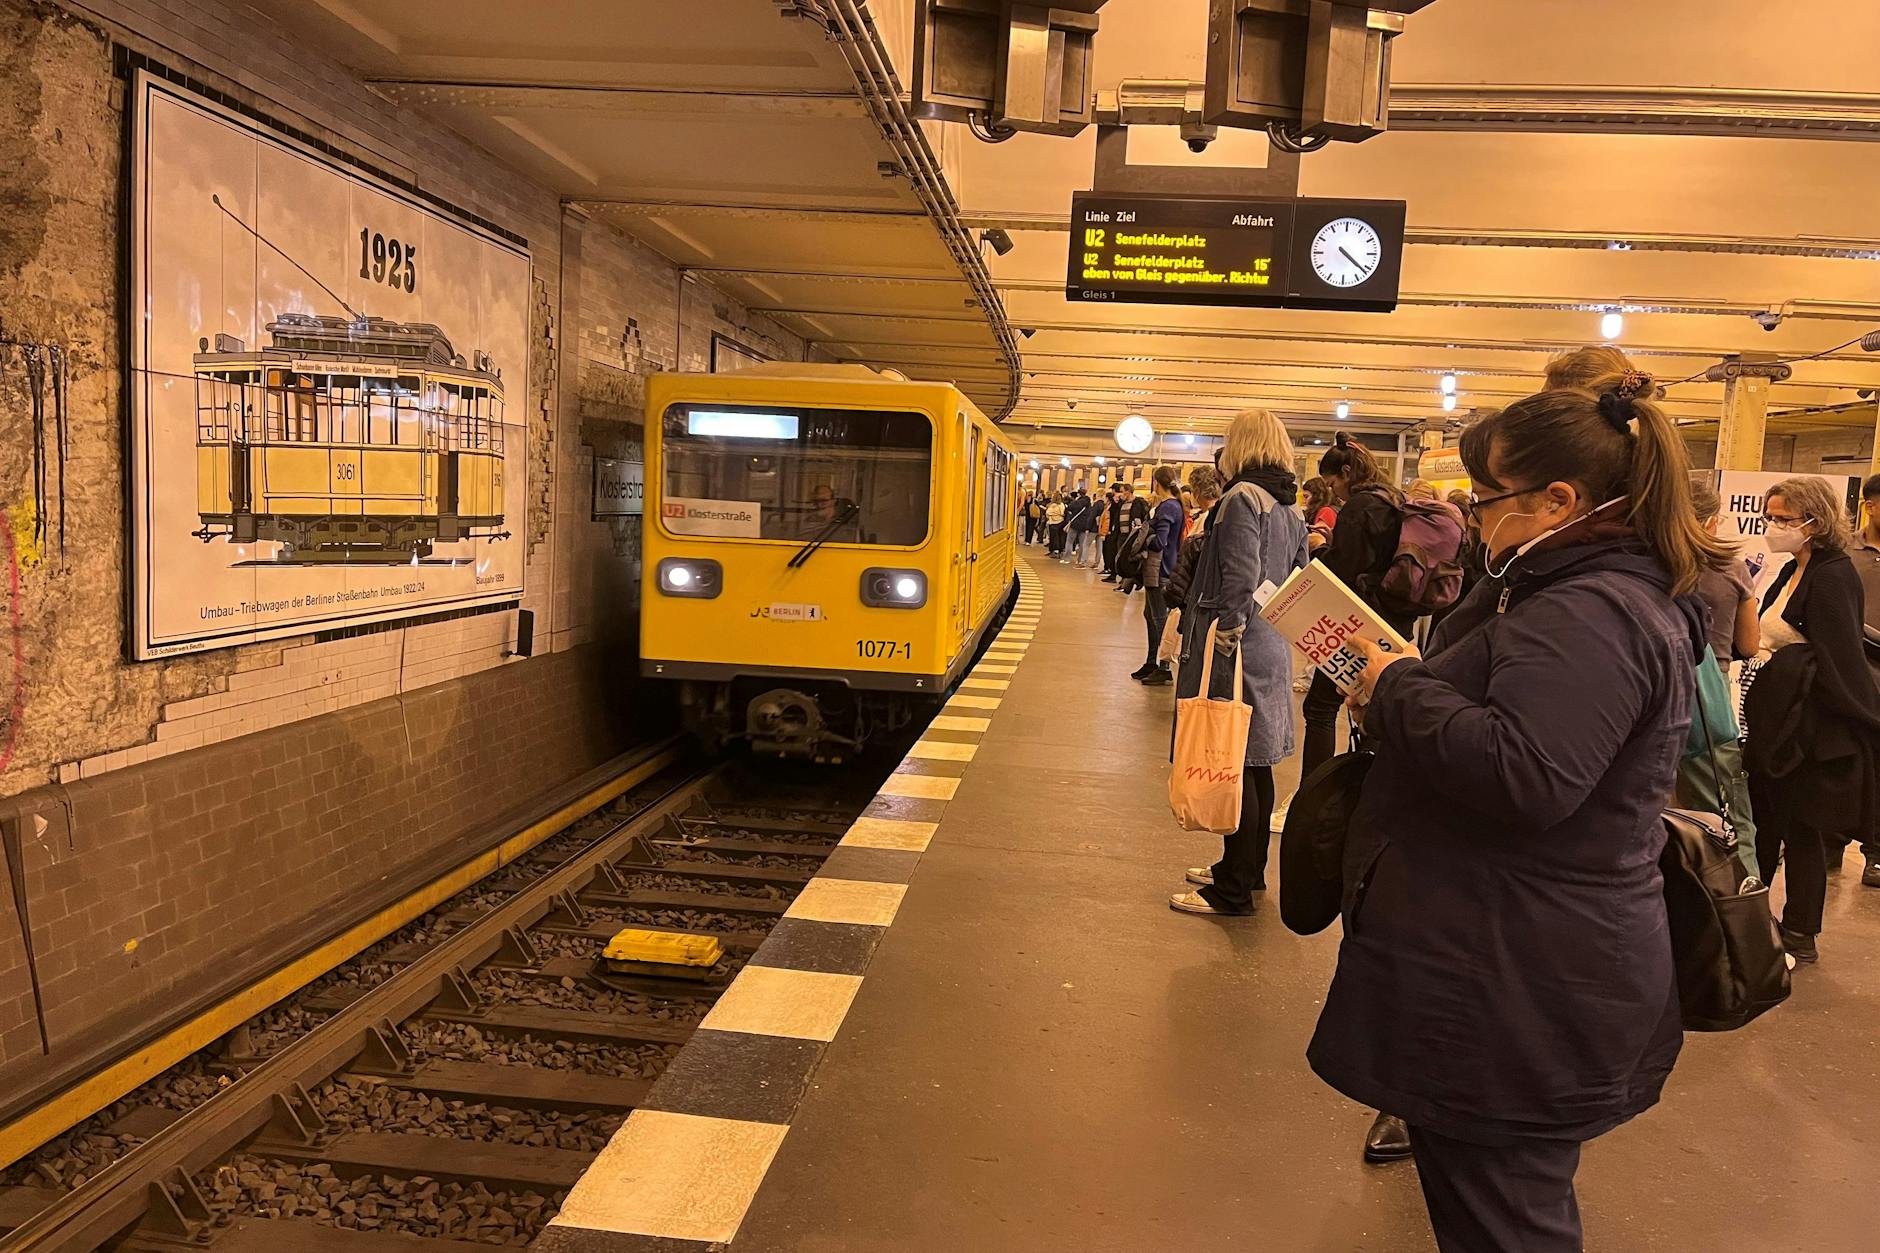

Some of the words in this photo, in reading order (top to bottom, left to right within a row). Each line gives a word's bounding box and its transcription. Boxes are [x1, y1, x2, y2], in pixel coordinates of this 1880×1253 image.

[1085, 211, 1110, 222] Linie
[1116, 211, 1136, 222] Ziel
[1232, 214, 1274, 227] Abfahrt
[1085, 228, 1106, 247] U2
[1115, 232, 1206, 249] Senefelderplatz
[359, 226, 416, 294] 1925
[1083, 253, 1099, 265] U2
[1114, 253, 1205, 269] Senefelderplatz
[1082, 266, 1110, 280] eben
[1135, 268, 1163, 282] Gleis
[1164, 270, 1228, 285] gegenüber.
[1082, 290, 1108, 300] Gleis
[1110, 290, 1116, 300] 1
[336, 463, 356, 481] 3061
[664, 505, 684, 518] U2
[687, 508, 752, 522] Klosterstraße
[1729, 494, 1766, 514] HEU
[291, 596, 304, 608] der
[305, 594, 335, 606] Berliner
[336, 588, 379, 603] Straßenbahn
[380, 586, 403, 598] Umbau
[773, 605, 801, 616] BERLIN
[1266, 610, 1280, 622] THE
[1308, 614, 1365, 665] PEOPLE
[856, 639, 911, 660] 1077-1
[1322, 646, 1356, 675] USE
[1334, 637, 1393, 687] THINS
